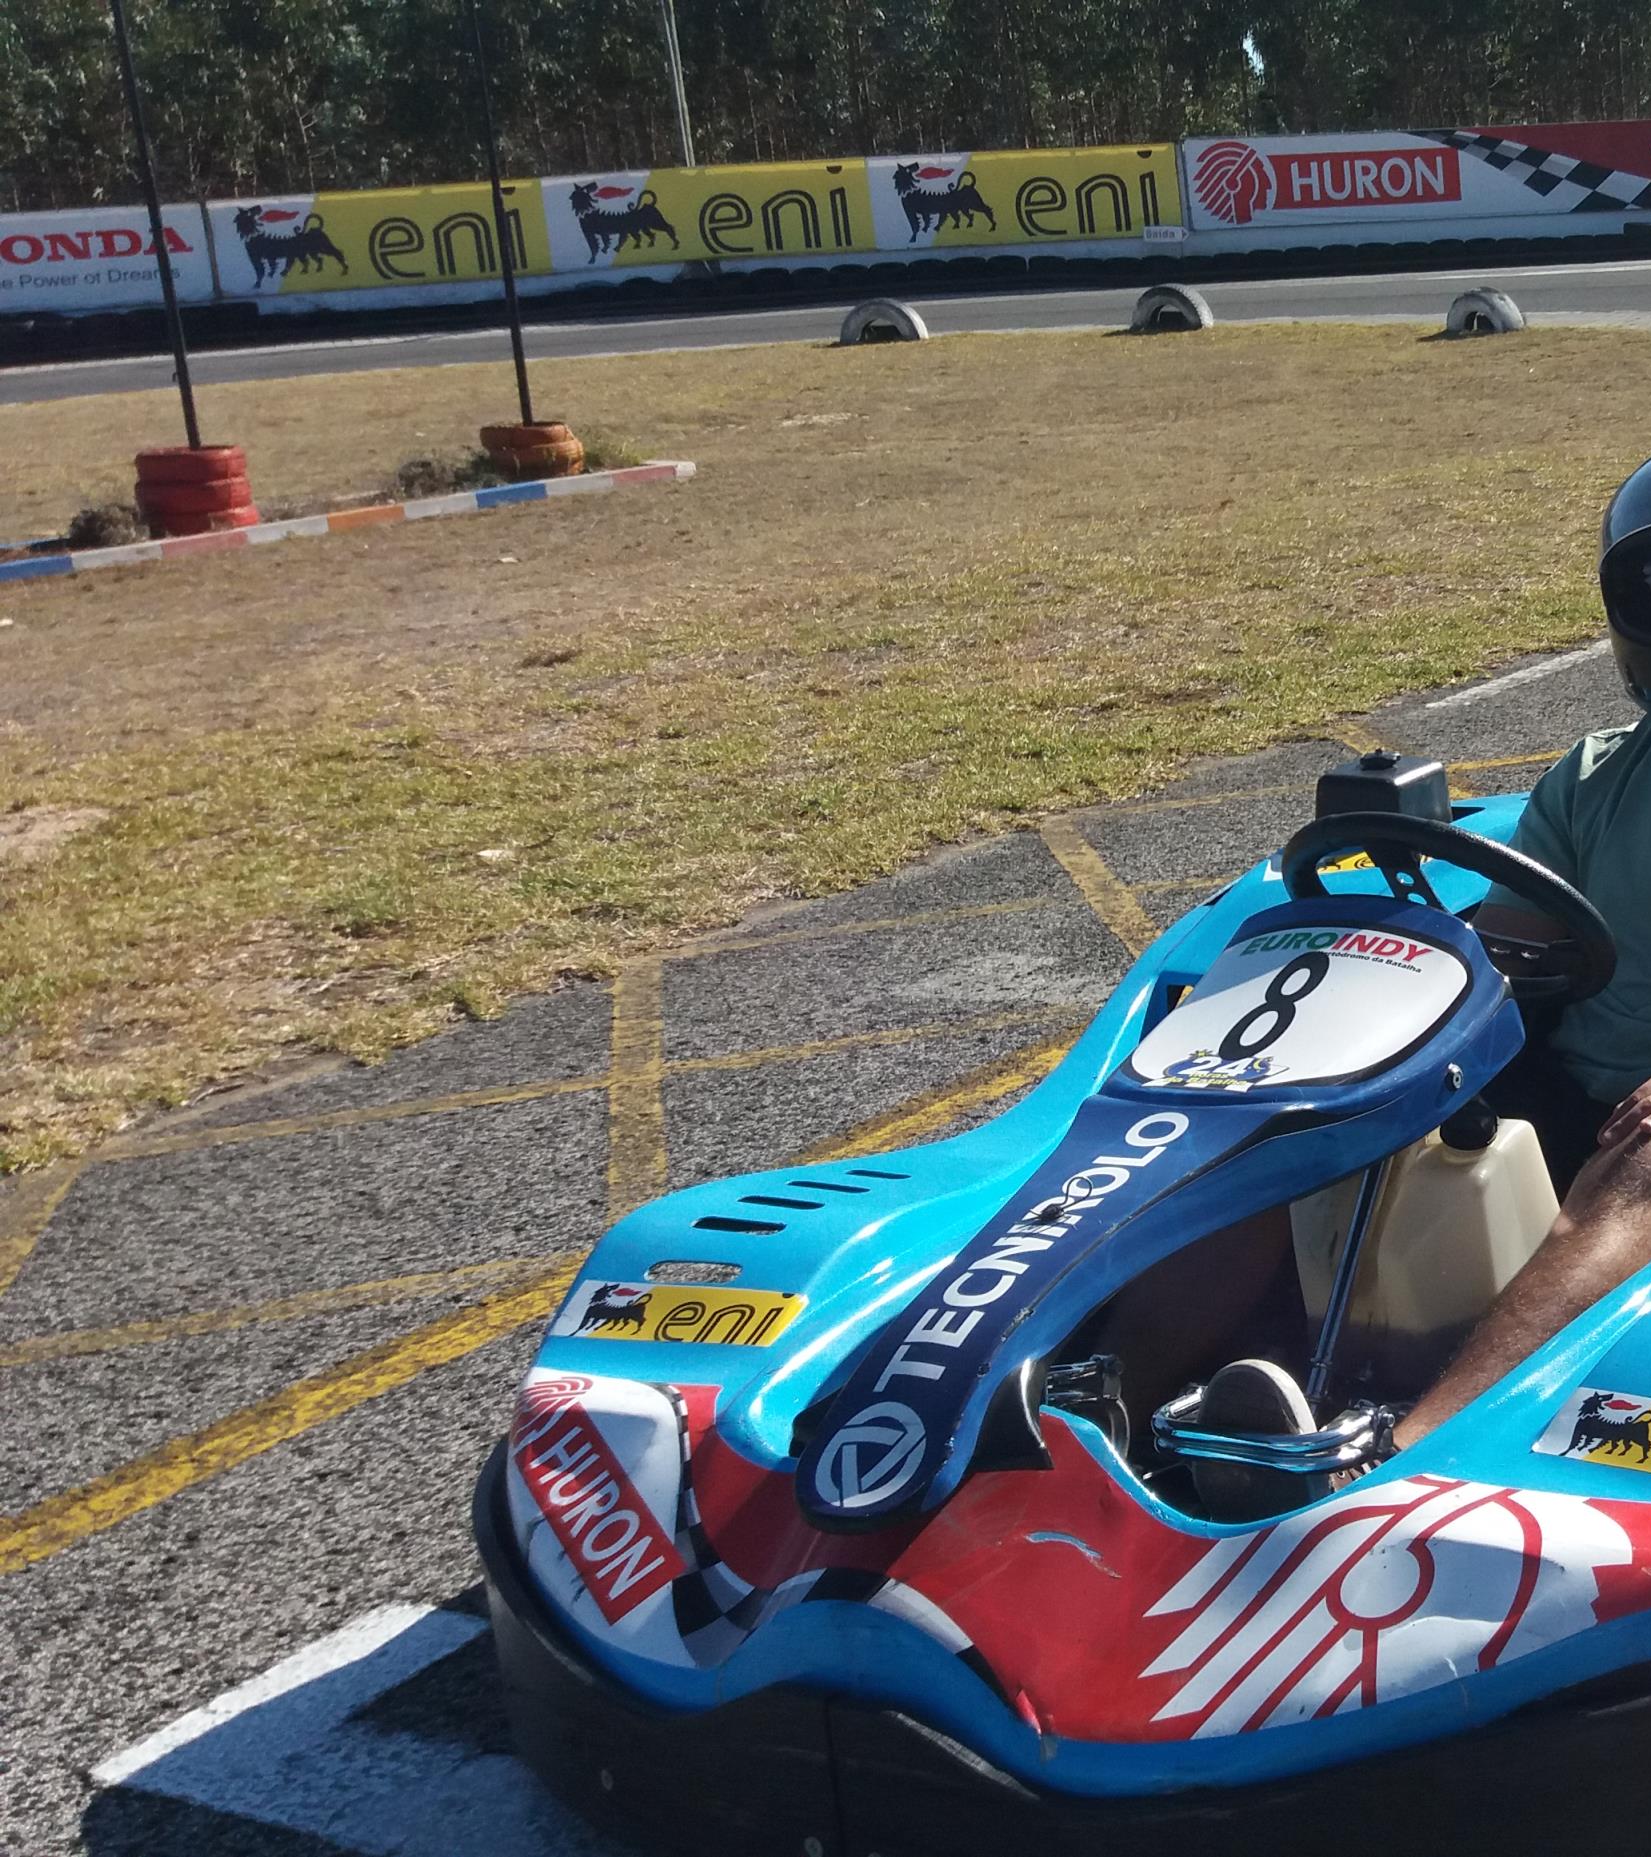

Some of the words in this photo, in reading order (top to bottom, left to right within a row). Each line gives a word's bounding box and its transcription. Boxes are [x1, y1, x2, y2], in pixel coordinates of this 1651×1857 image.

[1015, 149, 1160, 237] eni
[1290, 156, 1445, 202] HURON
[368, 186, 529, 280] eni
[700, 165, 853, 255] eni
[0, 227, 193, 265] ONDA
[20, 273, 77, 289] Power
[84, 271, 100, 284] of
[107, 267, 181, 284] Dreas
[1239, 931, 1434, 962] EUROINDY
[1385, 959, 1422, 974] Batalha
[1218, 951, 1330, 1060] 8
[1177, 1056, 1254, 1077] 24
[873, 1111, 1191, 1393] TECNIROLO
[654, 1292, 796, 1345] eni
[530, 1427, 665, 1600] HURON
